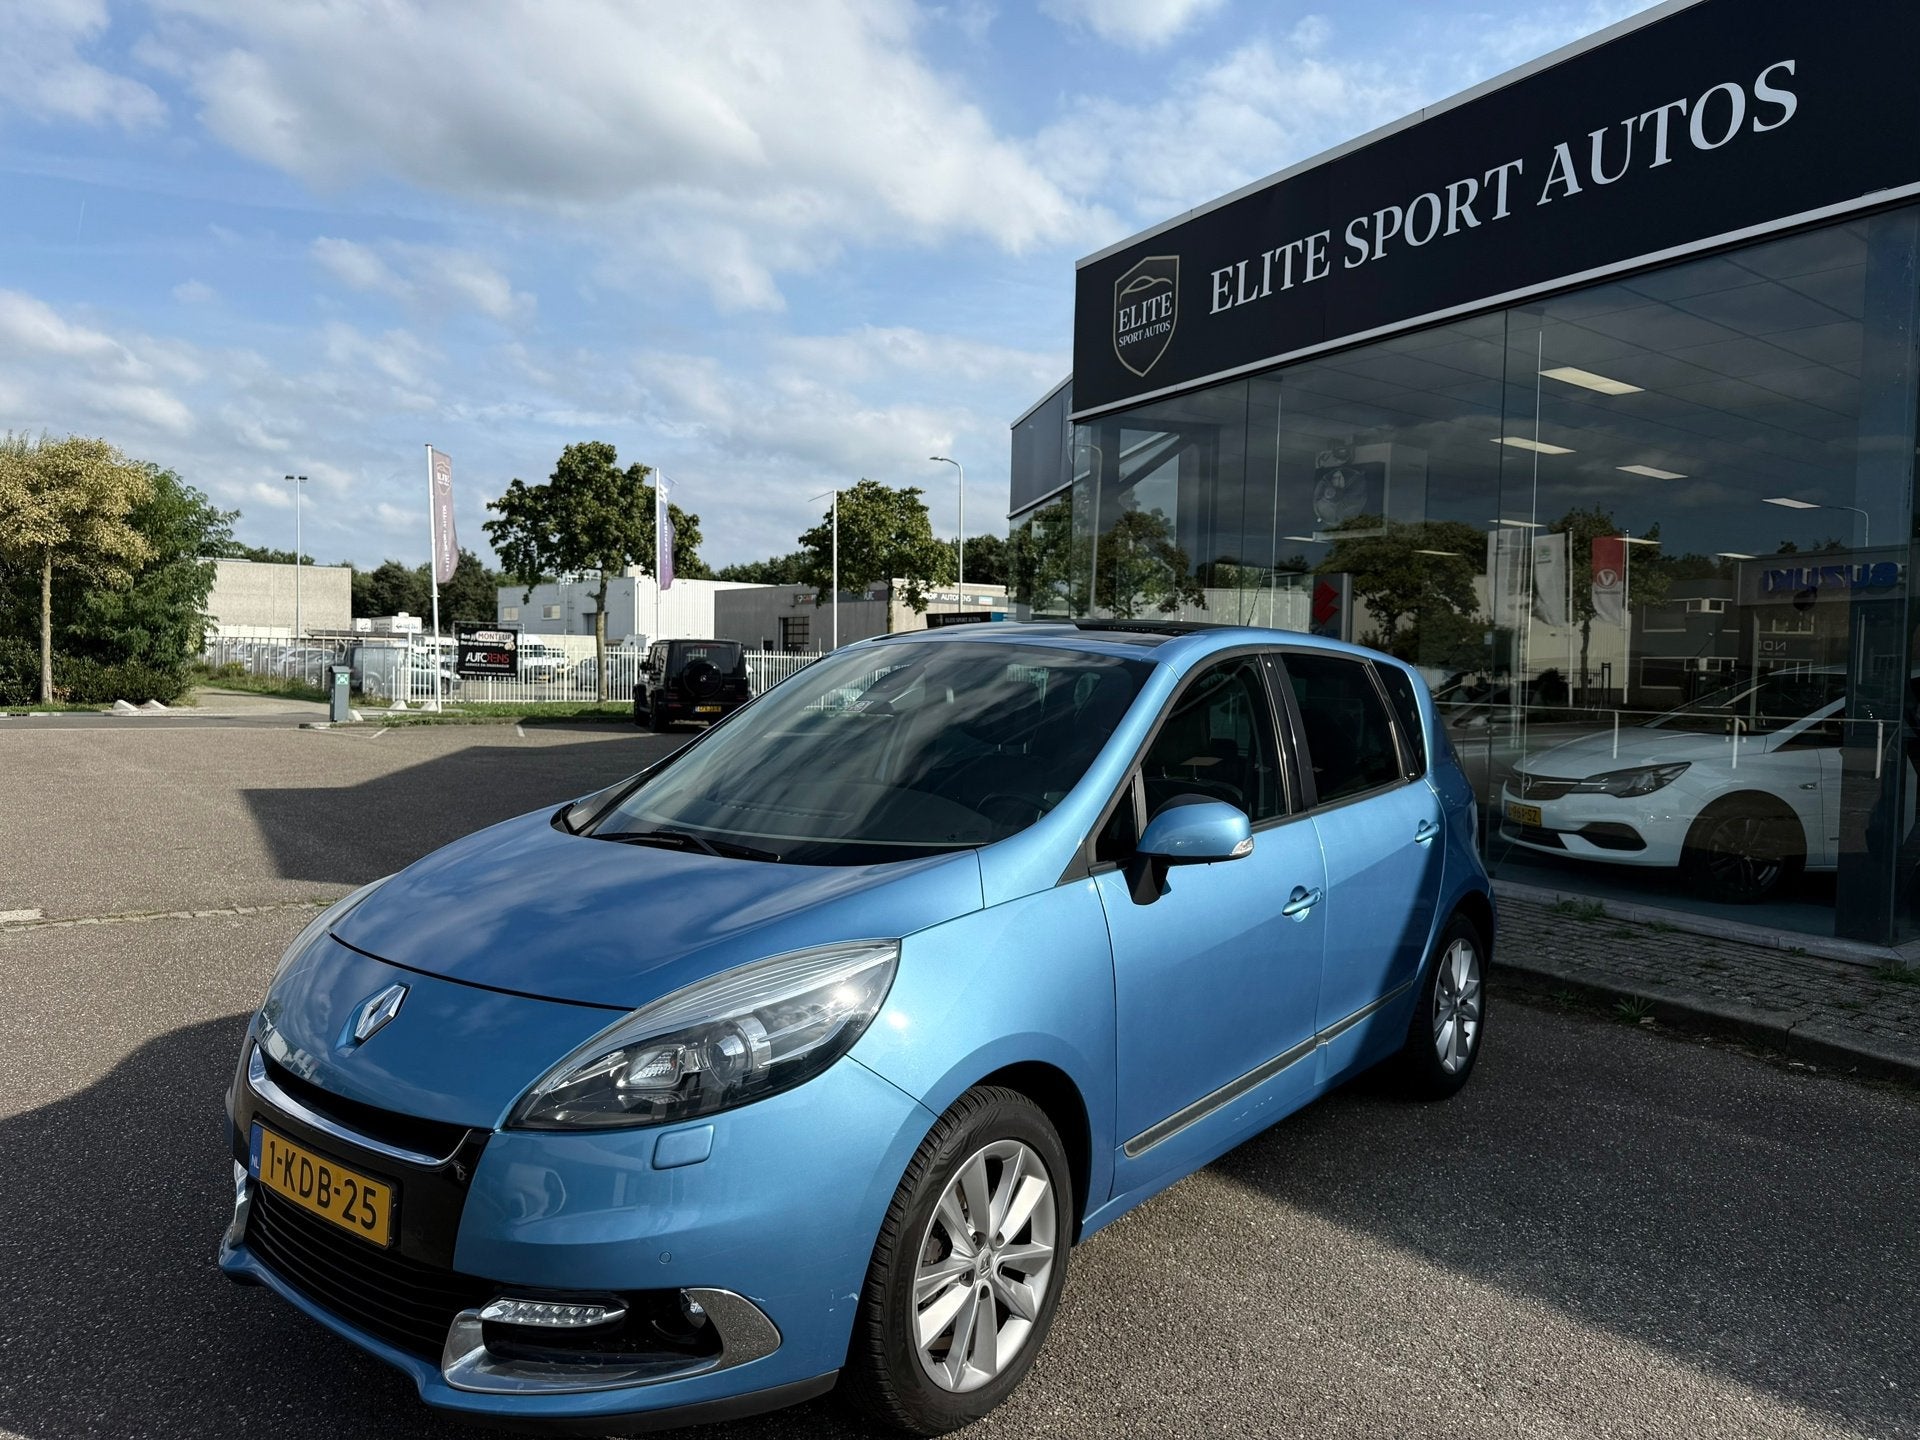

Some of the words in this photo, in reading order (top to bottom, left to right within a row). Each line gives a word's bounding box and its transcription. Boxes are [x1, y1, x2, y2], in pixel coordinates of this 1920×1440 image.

[1209, 229, 1330, 315] ELITE
[1344, 158, 1523, 269] SPORT
[1536, 60, 1798, 206] AUTOS
[1118, 292, 1172, 333] ELITE
[1119, 330, 1144, 347] SPORT
[1144, 320, 1170, 339] AUTOS
[250, 1155, 260, 1170] NL
[269, 1141, 377, 1231] 1-KDB-25
